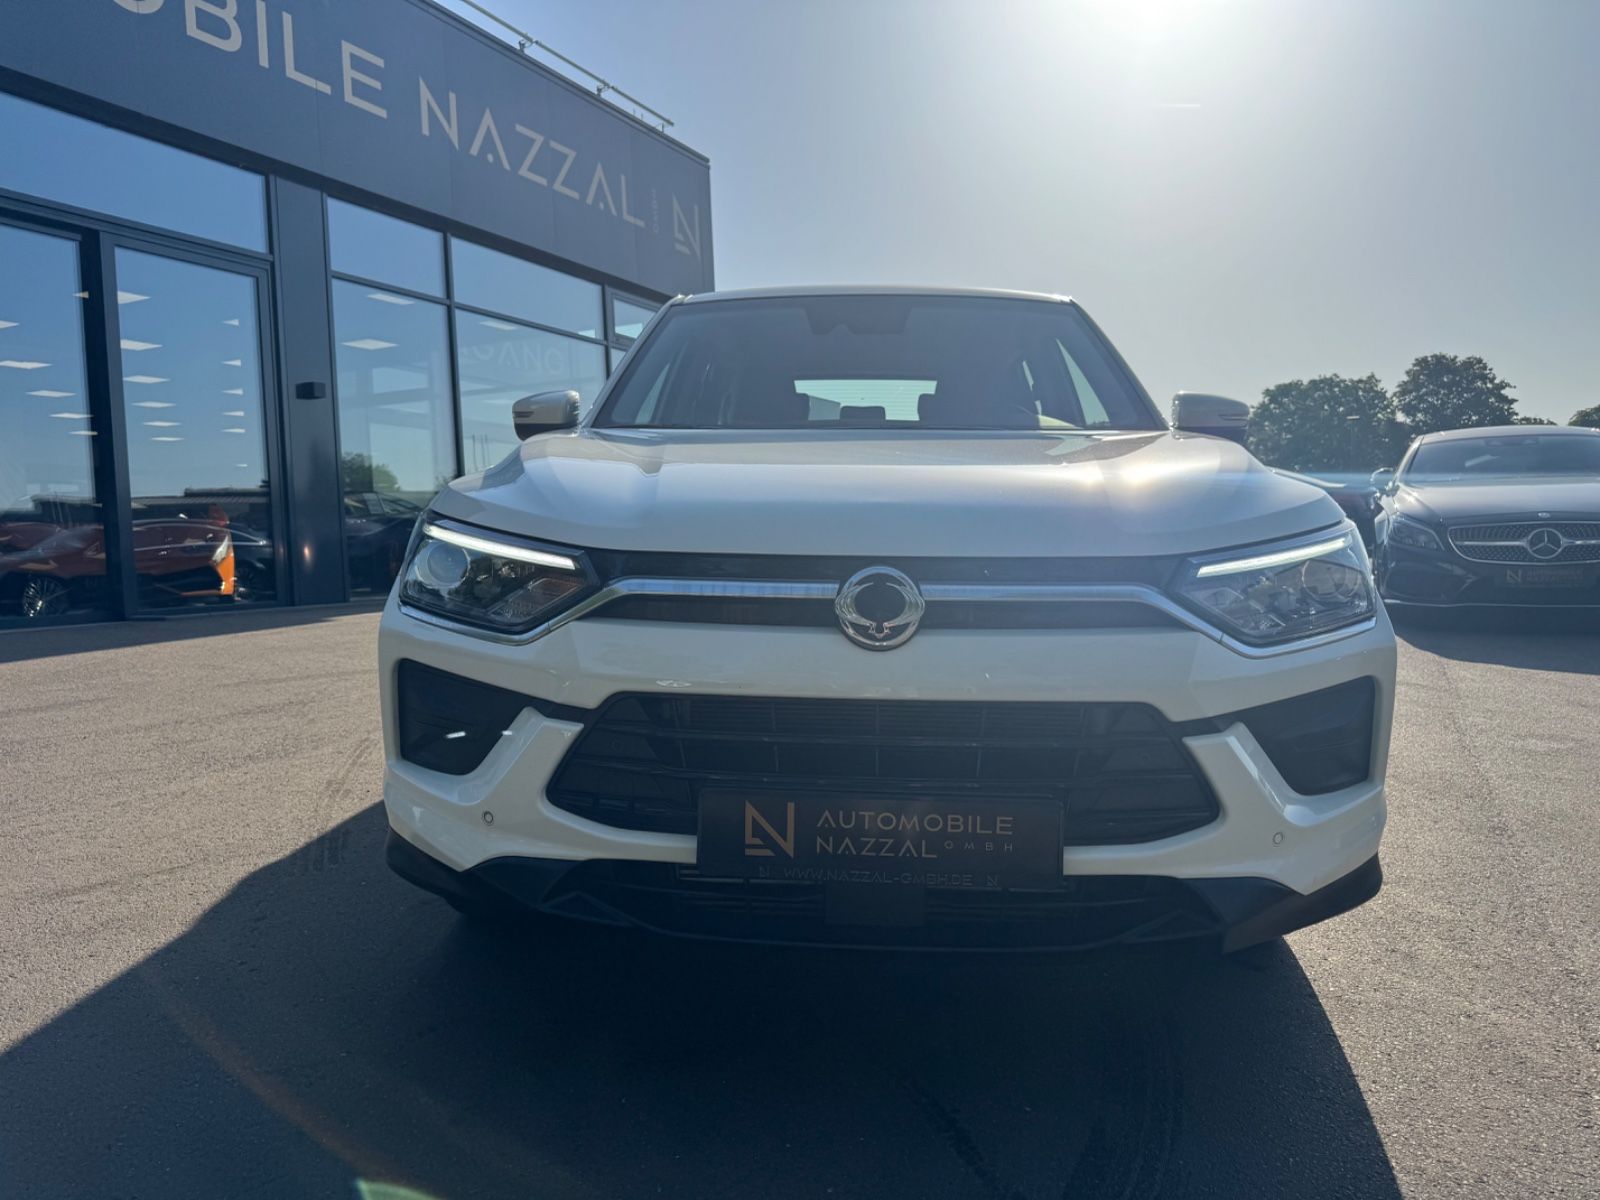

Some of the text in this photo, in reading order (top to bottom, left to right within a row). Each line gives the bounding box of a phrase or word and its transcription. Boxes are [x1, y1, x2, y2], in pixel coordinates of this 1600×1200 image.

[112, 0, 645, 228] BILE NAZZAL
[816, 809, 1014, 835] AUTOMOBILE
[816, 835, 938, 859] NAZZAL
